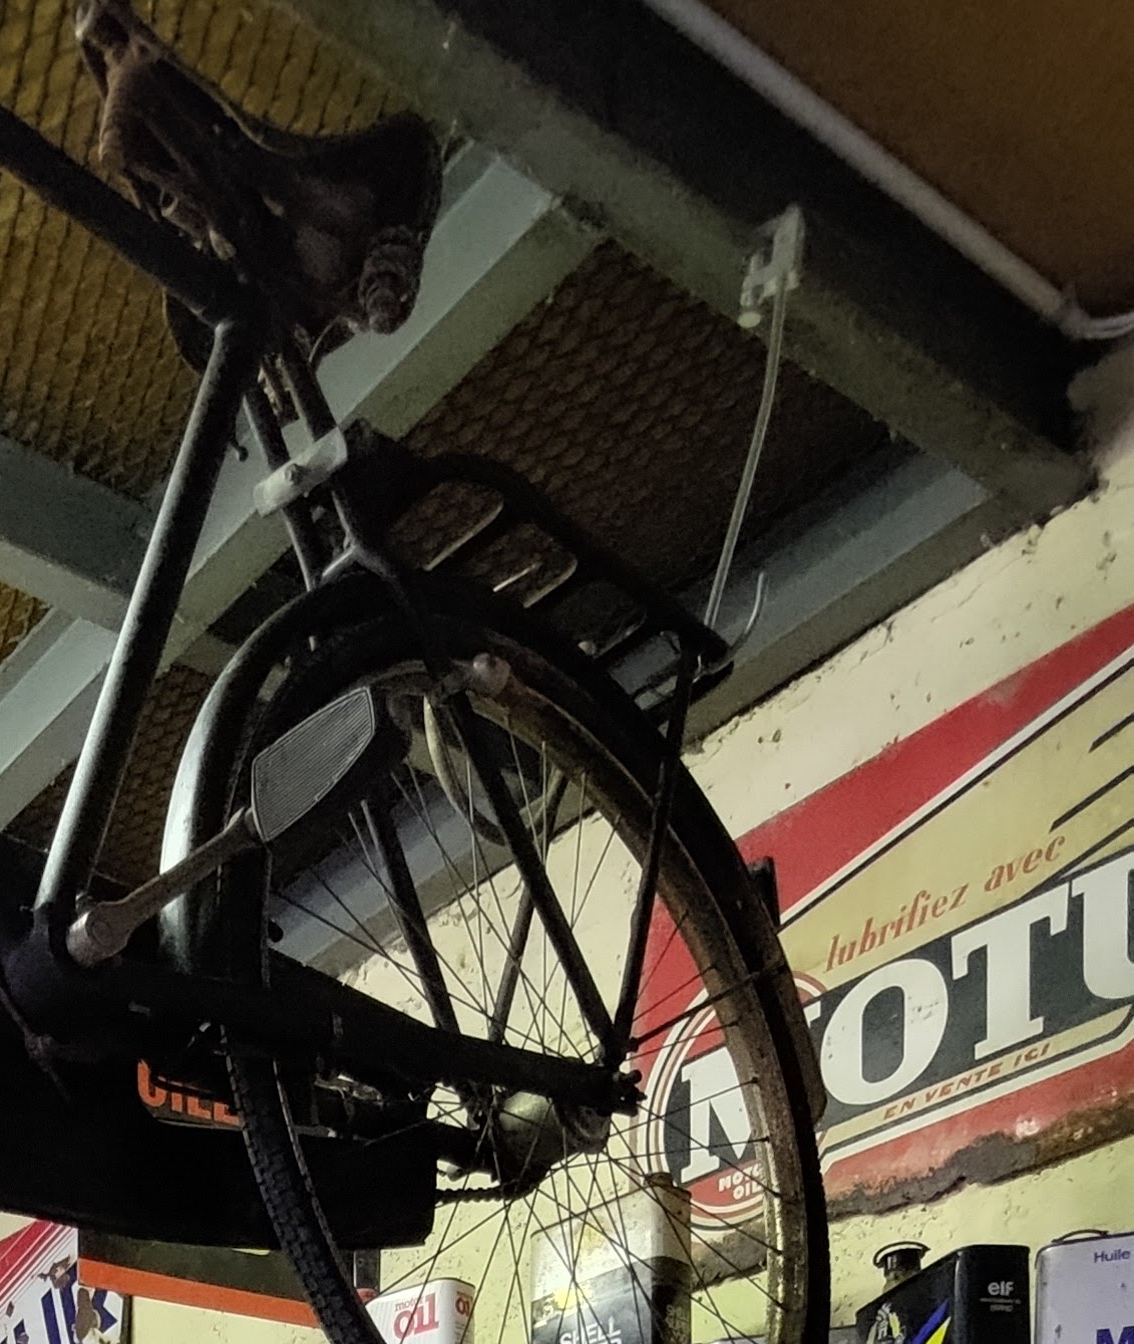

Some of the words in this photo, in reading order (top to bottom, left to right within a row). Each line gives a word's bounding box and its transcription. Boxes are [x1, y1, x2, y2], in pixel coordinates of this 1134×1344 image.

[822, 882, 970, 973] lubrifiez
[983, 834, 1067, 893] avec
[883, 1095, 916, 1120] EN
[924, 1060, 1003, 1105] VENTE
[1013, 1041, 1051, 1068] ICI
[1094, 1249, 1131, 1264] Huile
[987, 1280, 1015, 1297] elf
